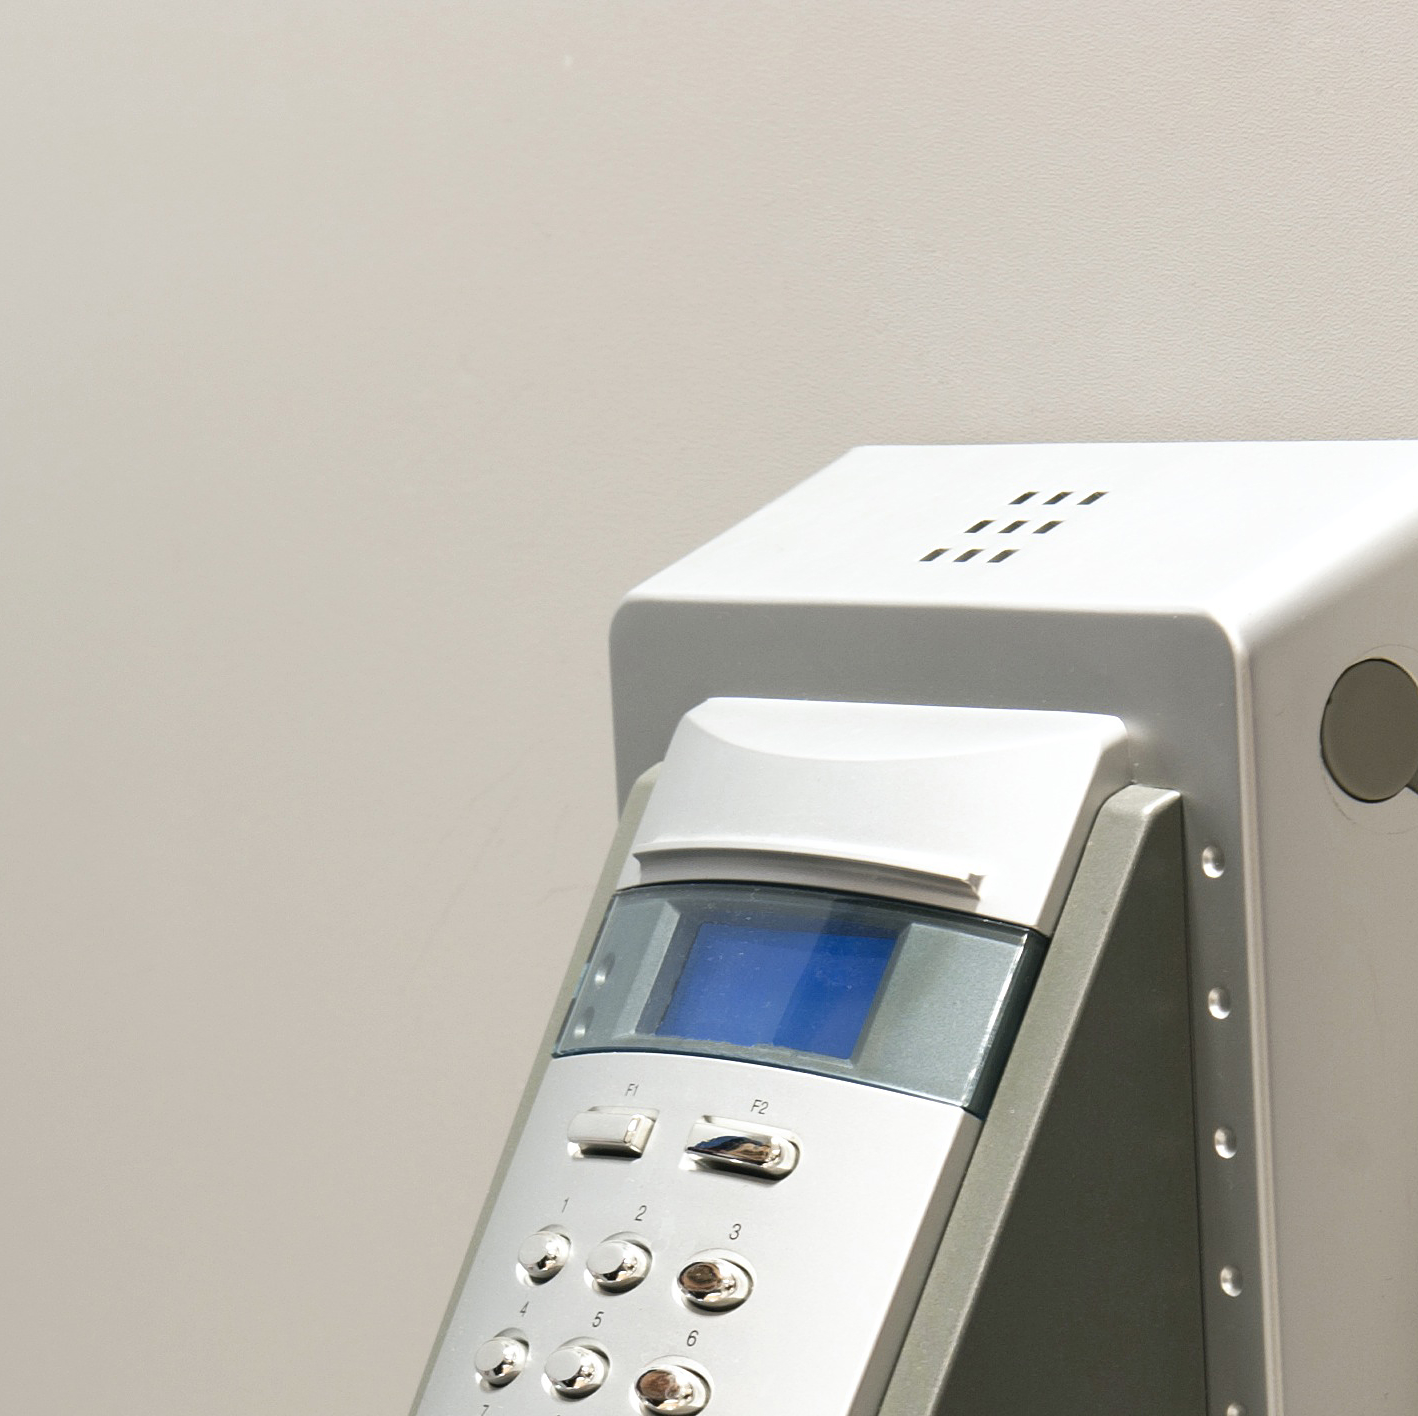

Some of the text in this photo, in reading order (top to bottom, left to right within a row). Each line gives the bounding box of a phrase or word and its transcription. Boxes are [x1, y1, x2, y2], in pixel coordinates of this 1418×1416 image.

[624, 1083, 640, 1097] F1
[749, 1098, 769, 1115] F2
[561, 1197, 570, 1214] 1
[633, 1204, 648, 1222] 2
[728, 1223, 742, 1241] 3
[519, 1300, 530, 1317] 4
[591, 1310, 605, 1328] 5
[686, 1329, 700, 1348] 6
